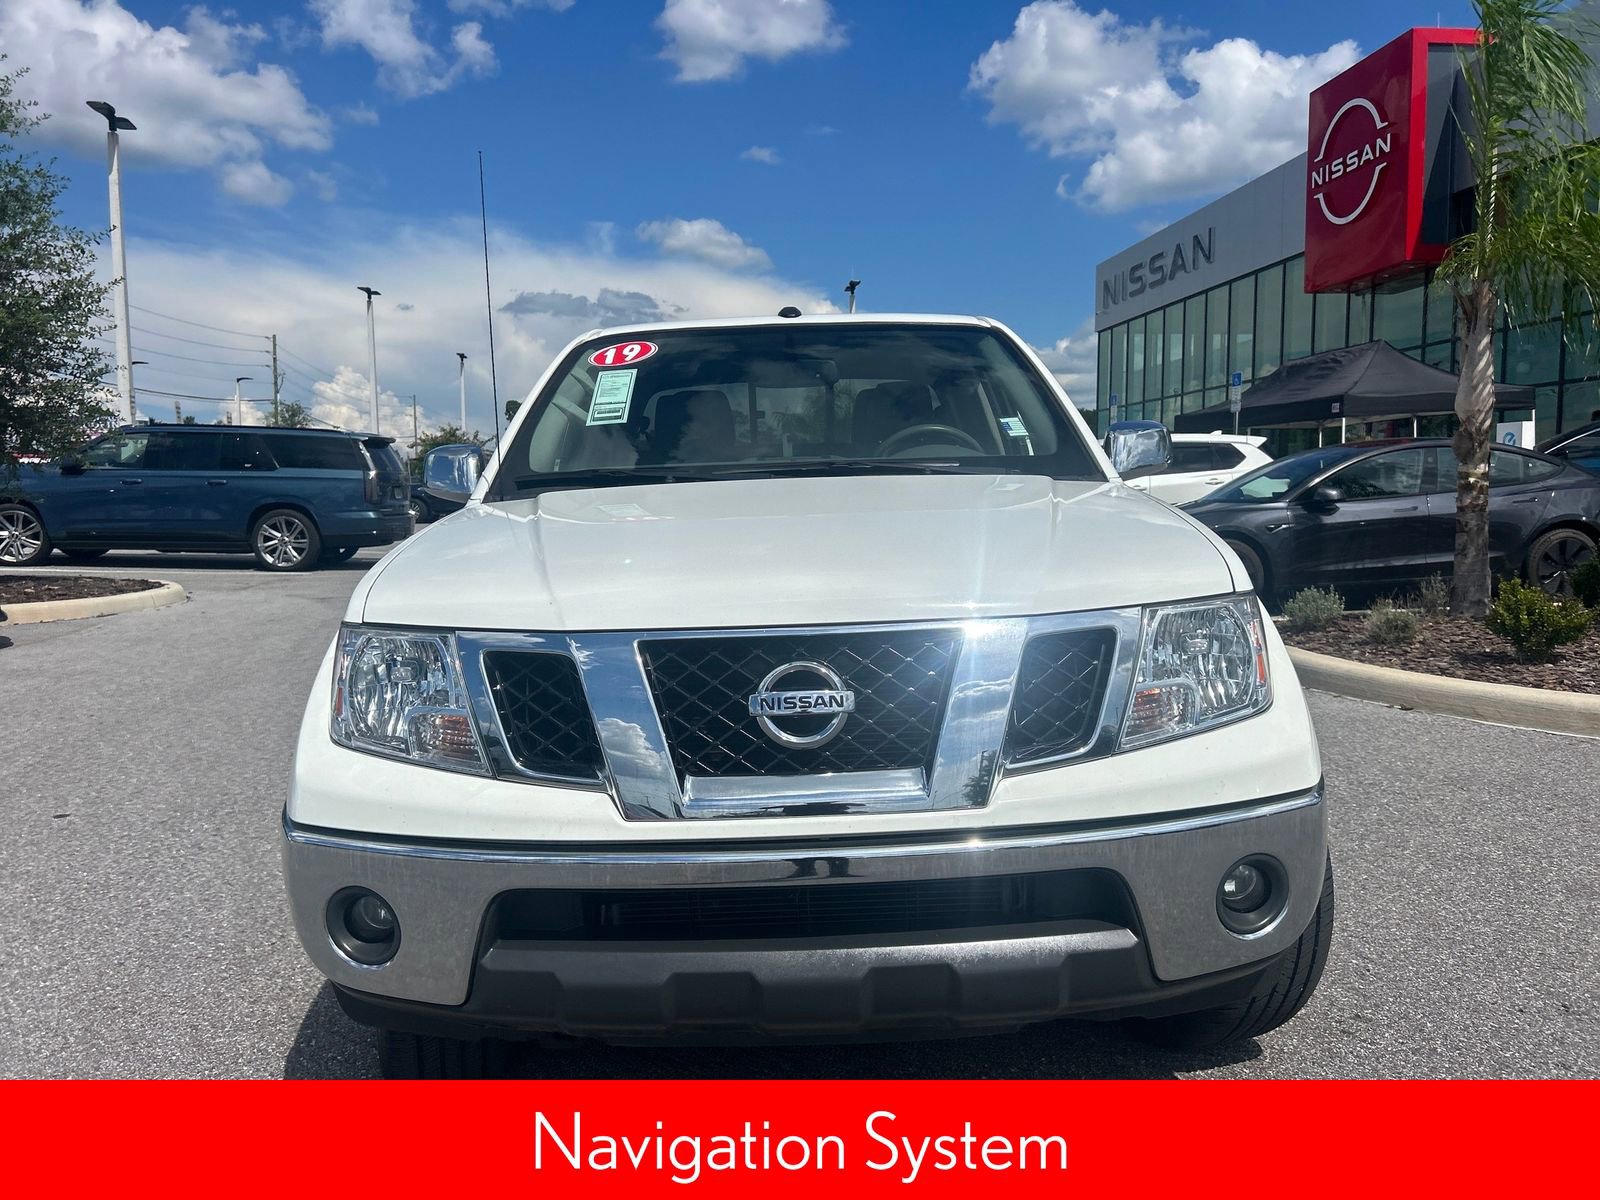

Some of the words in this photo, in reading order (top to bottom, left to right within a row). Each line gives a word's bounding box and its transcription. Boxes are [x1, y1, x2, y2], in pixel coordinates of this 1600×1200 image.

[1311, 132, 1391, 189] NISSAN
[1102, 226, 1216, 310] NISSAN
[604, 344, 642, 365] 19
[760, 695, 844, 711] NISSAN
